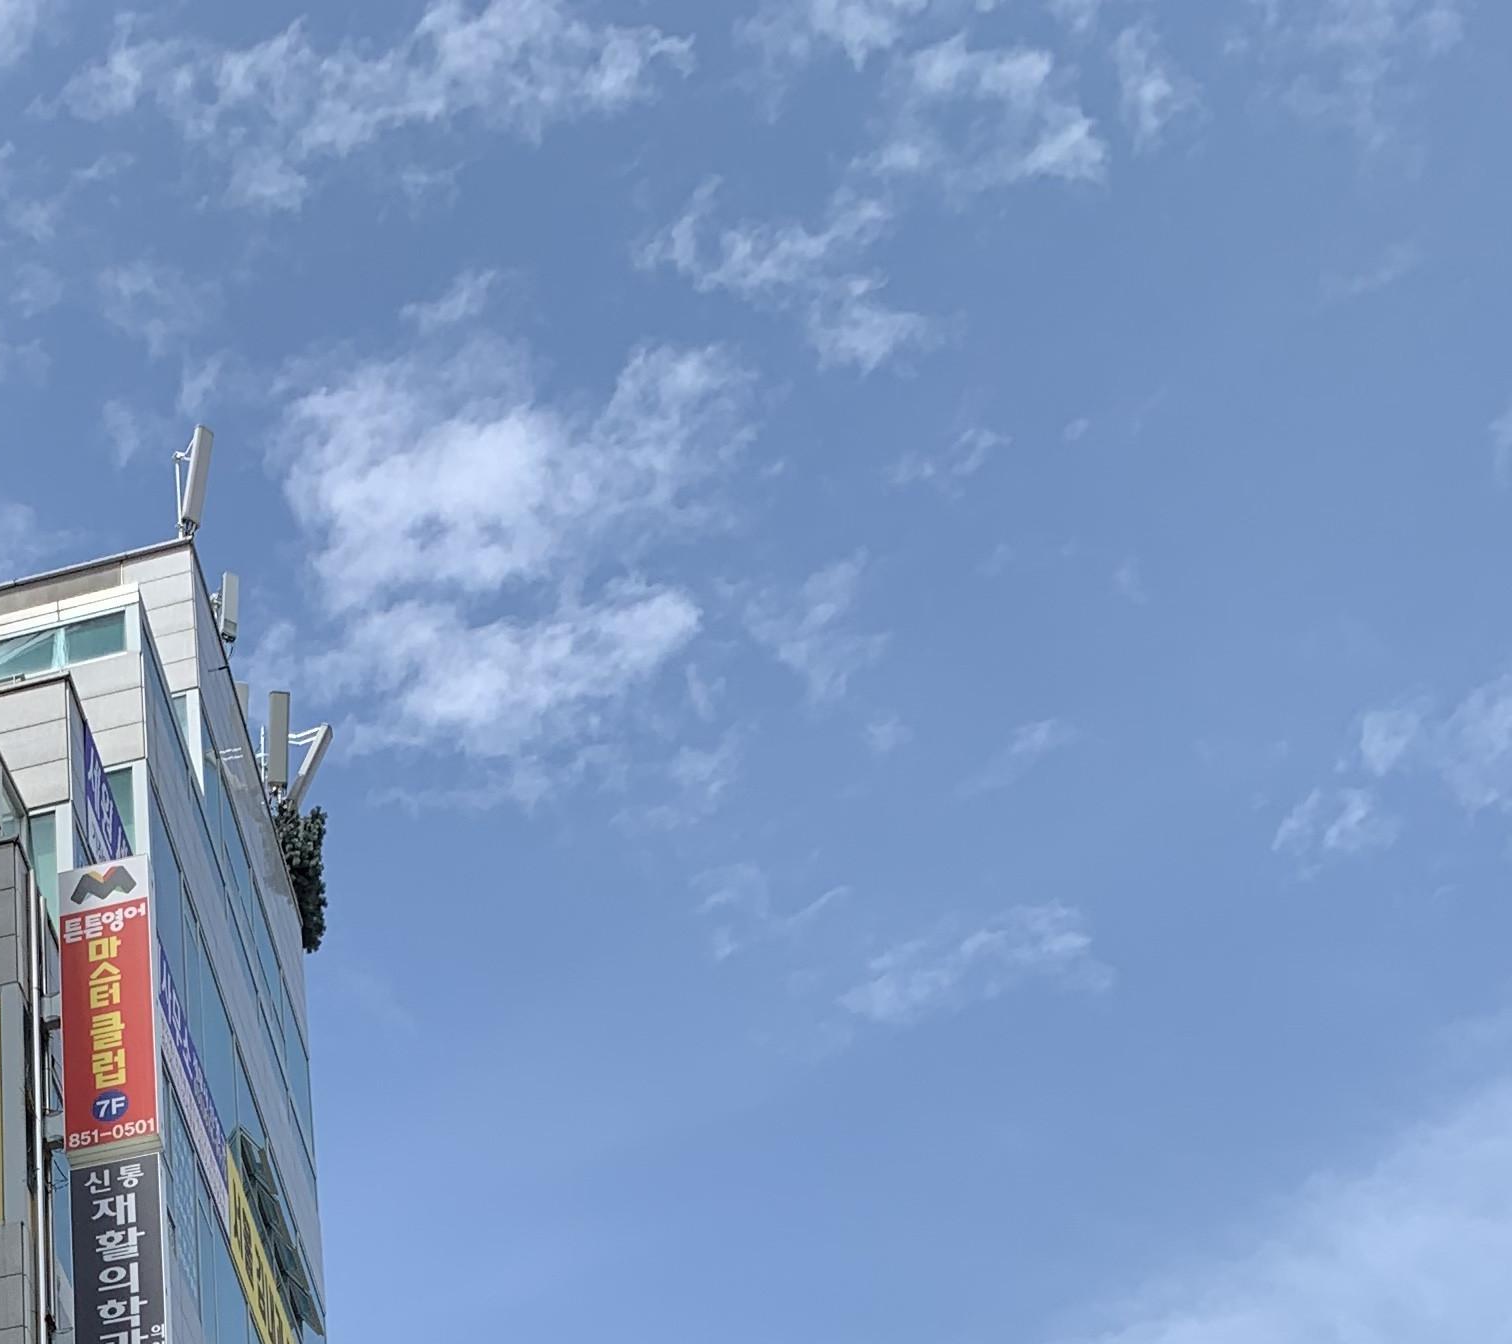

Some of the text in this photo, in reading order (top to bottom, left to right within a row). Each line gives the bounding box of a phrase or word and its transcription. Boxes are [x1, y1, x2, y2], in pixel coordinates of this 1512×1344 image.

[63, 904, 146, 944] 튼튼영어
[96, 1094, 126, 1118] 7F
[68, 1117, 156, 1149] 851-0501
